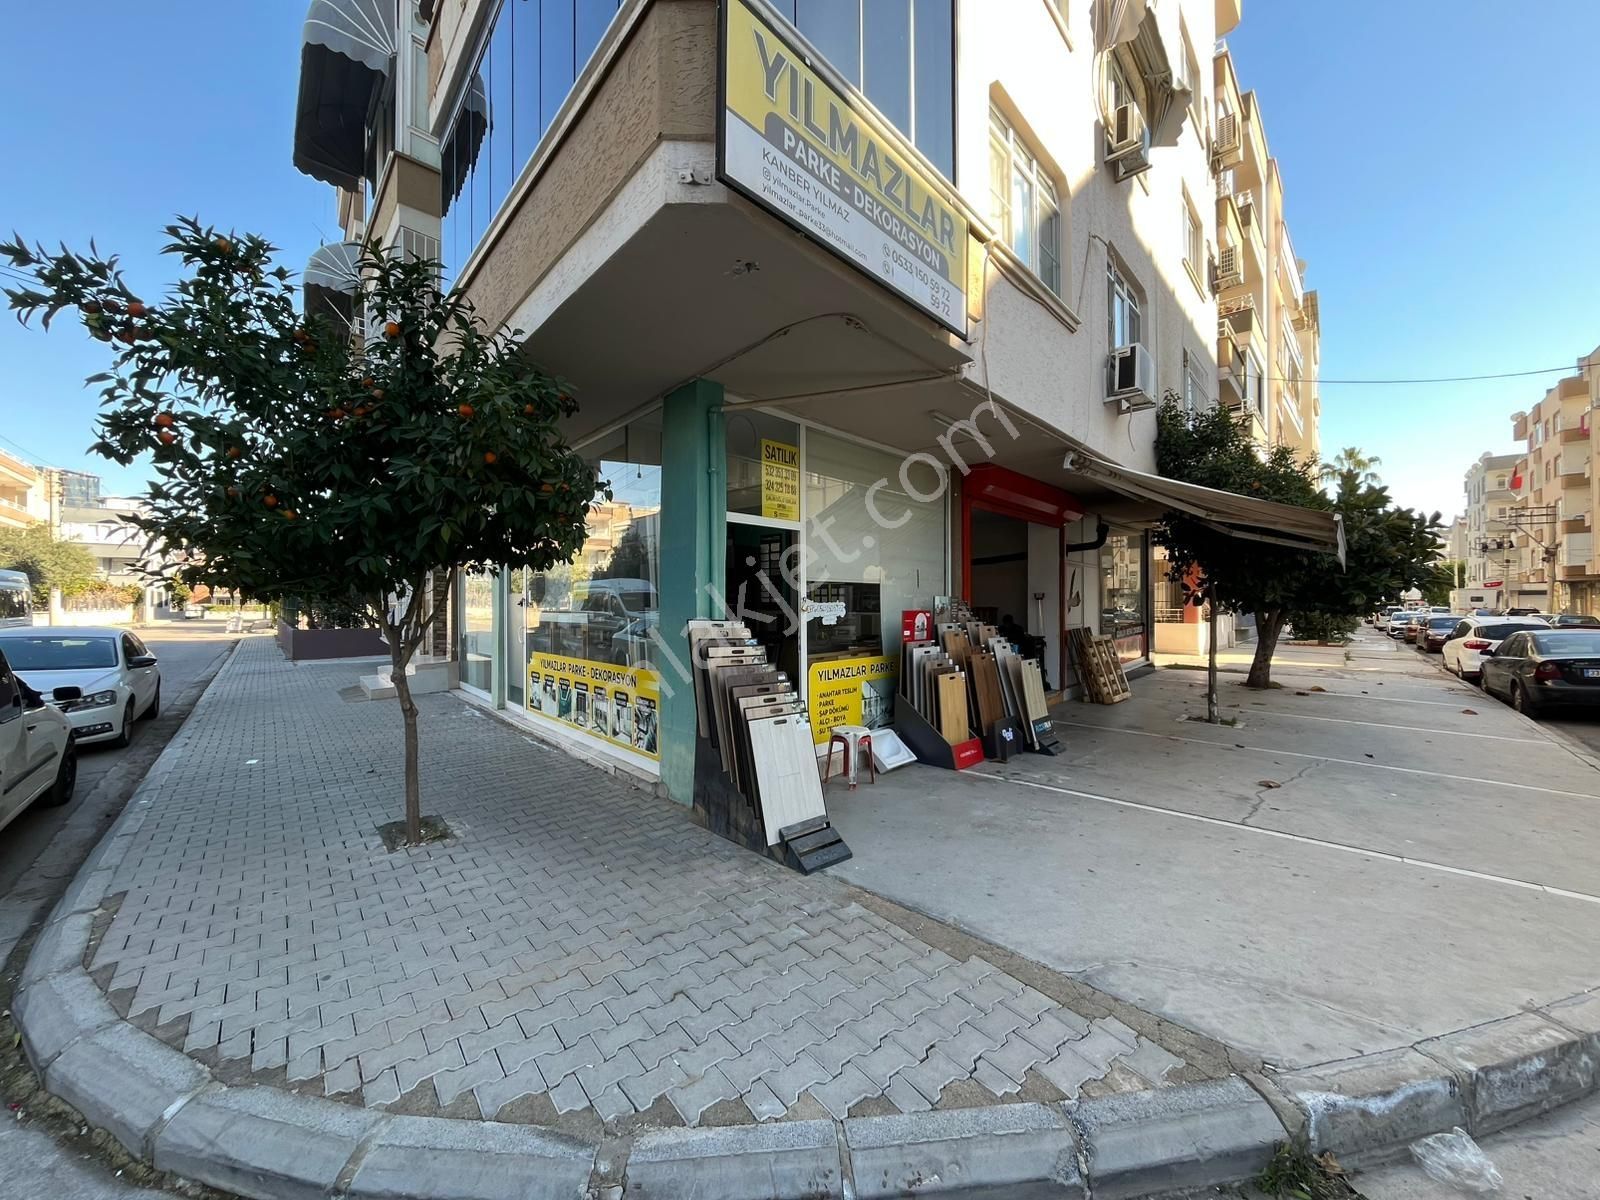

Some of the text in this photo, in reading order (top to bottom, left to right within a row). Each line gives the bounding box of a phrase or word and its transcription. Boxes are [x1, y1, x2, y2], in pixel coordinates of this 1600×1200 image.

[753, 27, 957, 258] YILMAZLAR
[762, 147, 850, 223] KANBER YILMAZ
[783, 127, 841, 194] PARKE
[854, 185, 941, 270] DEKORASYON
[892, 250, 951, 303] 0533 150 59 72
[930, 294, 951, 318] 59 72
[765, 444, 797, 467] SATILIK
[540, 658, 567, 673] YILMAZLAR
[568, 663, 586, 678] PARKE
[590, 667, 637, 688] DEKORASYON
[817, 661, 895, 682] YILMAZLAR PARKE
[819, 689, 841, 699] ANAHTAR
[819, 699, 835, 708] PARKE
[834, 714, 846, 723] BOYA
